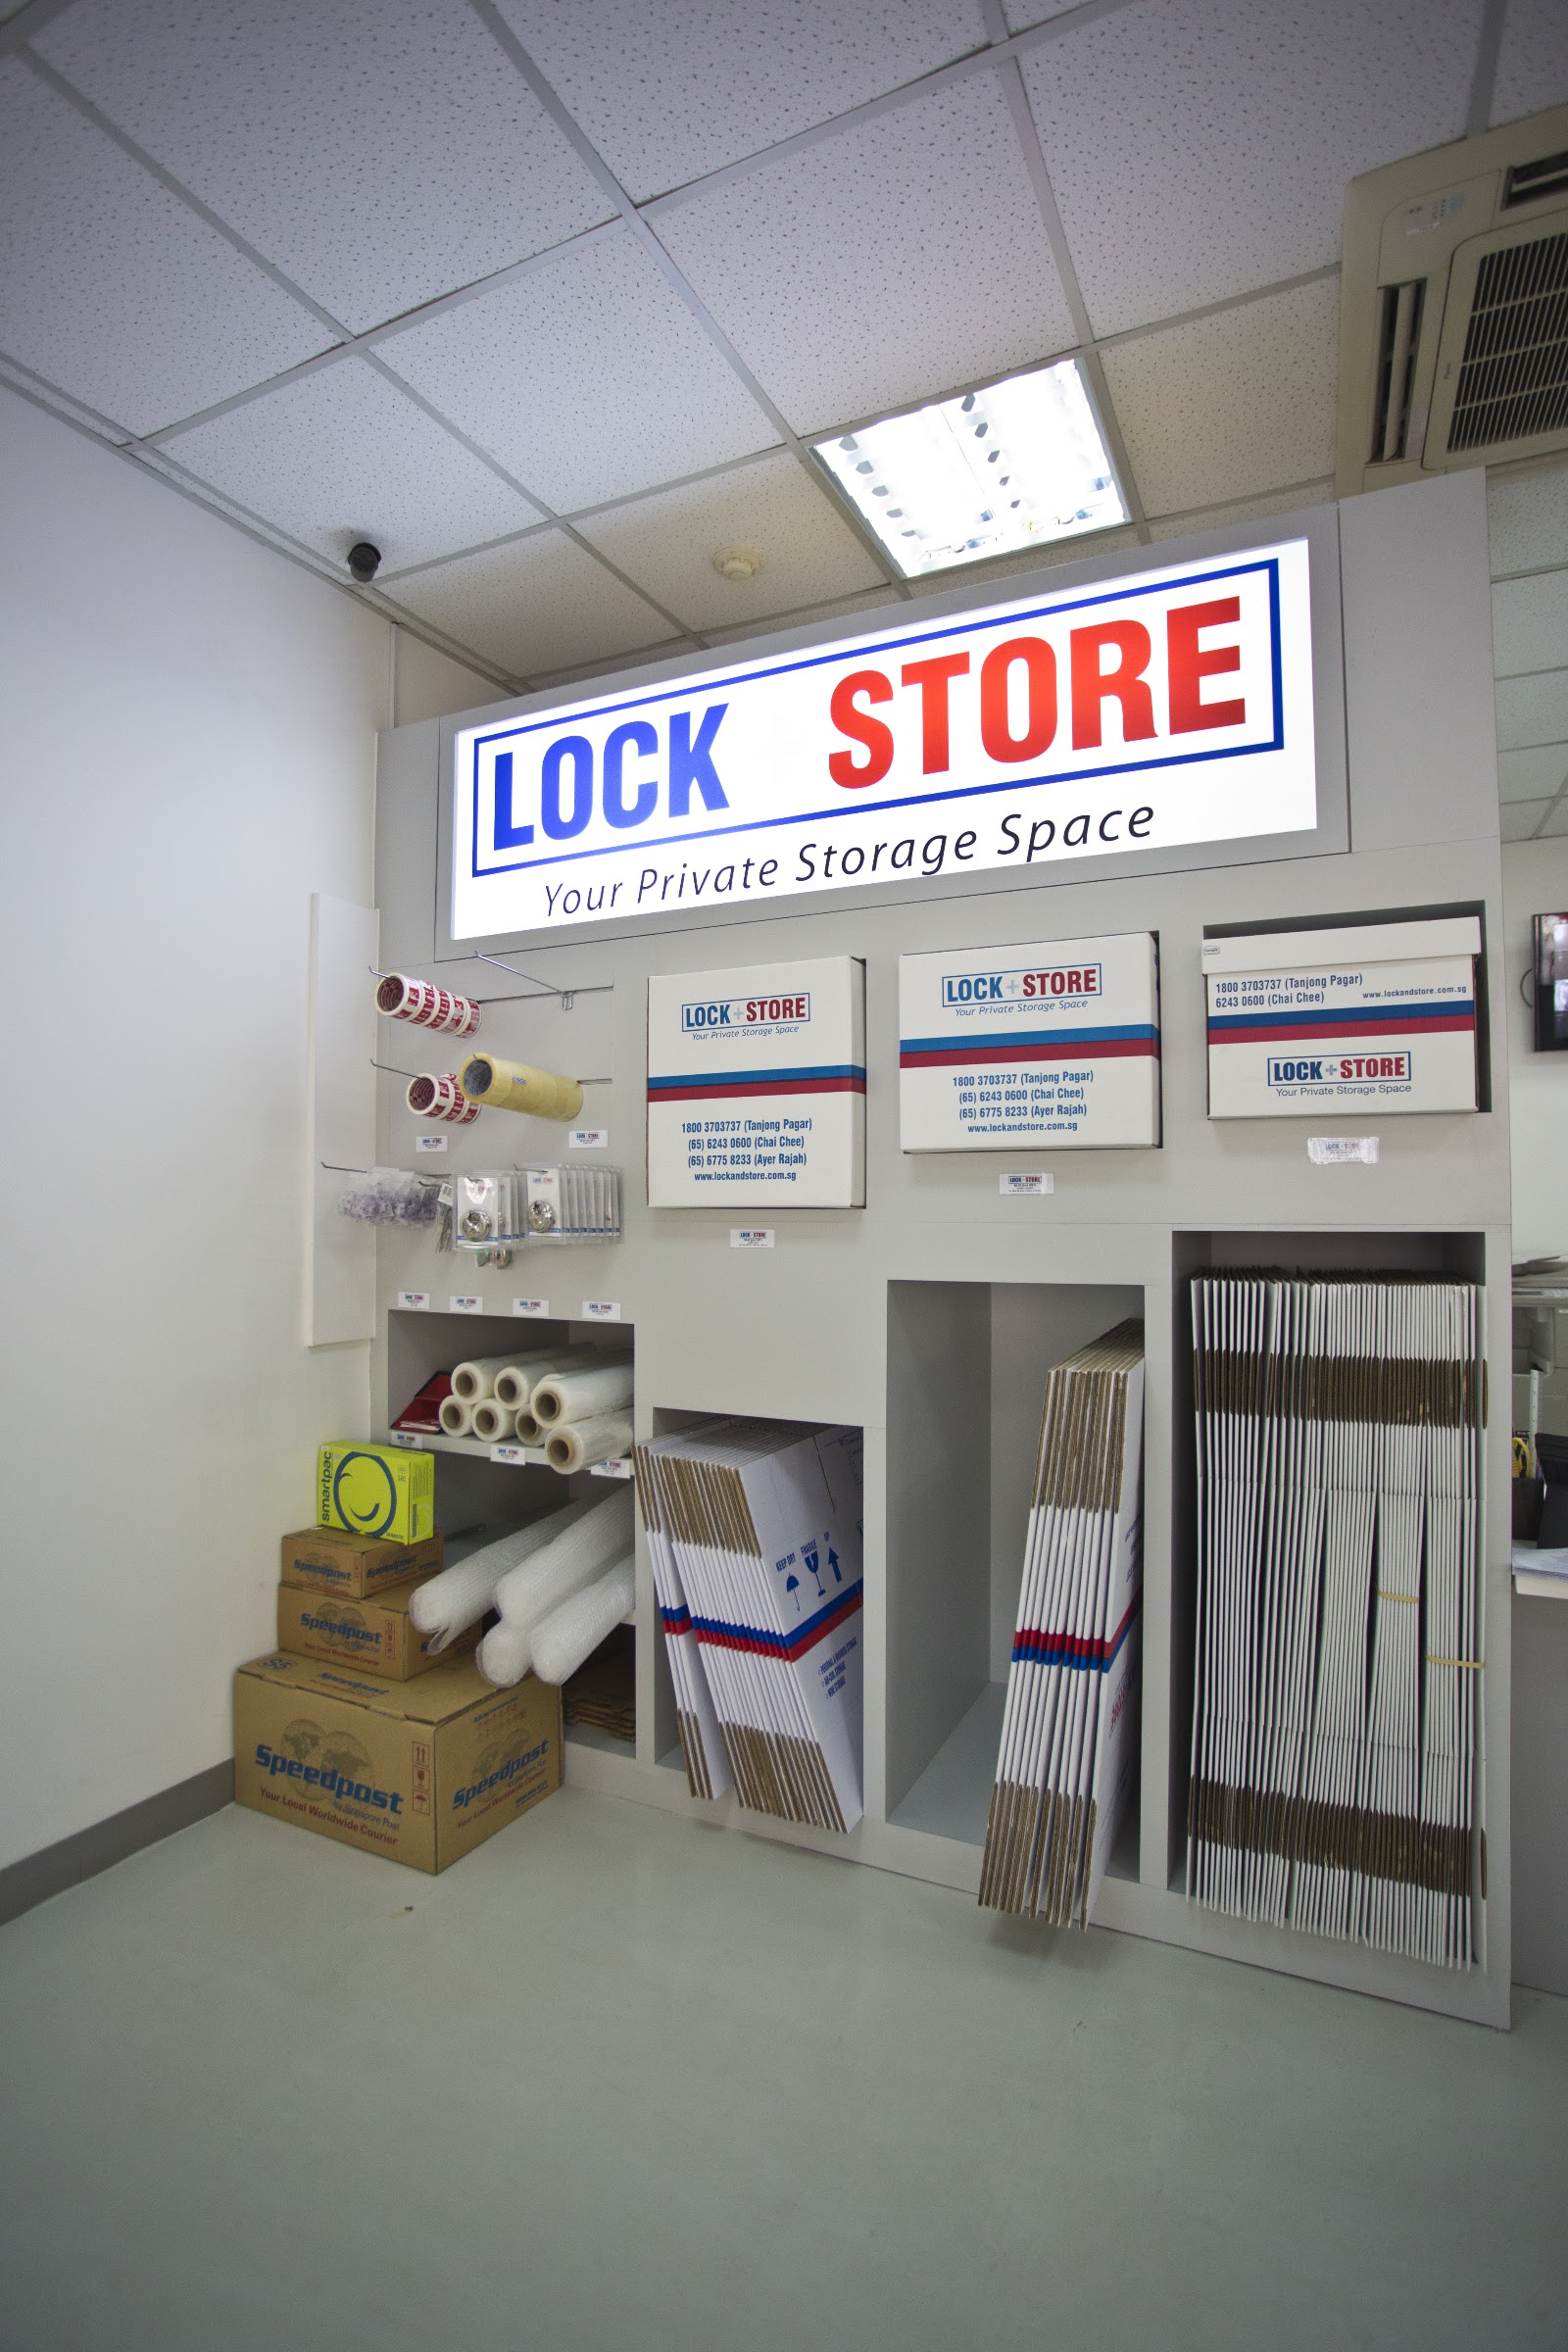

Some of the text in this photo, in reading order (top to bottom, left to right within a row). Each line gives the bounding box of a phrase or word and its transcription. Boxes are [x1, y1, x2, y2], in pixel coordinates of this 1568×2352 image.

[494, 596, 1245, 851] LOCK STORE
[544, 806, 1154, 917] Your Private Storage Space
[947, 976, 1003, 1002] LOCK
[1023, 969, 1097, 997] STORE
[1215, 973, 1362, 994] 1800 3703737 (Tanjong Pagar)
[1215, 992, 1325, 1007] 6243 0600 (Chai Chee)
[1362, 986, 1466, 999] www.lockandstore.com.sg
[686, 1004, 730, 1027] LOCK
[746, 997, 806, 1021] STORE
[956, 1000, 1088, 1016] Your Private Storage Space
[711, 1029, 739, 1039] Private
[742, 1027, 772, 1037] Storage
[775, 1025, 799, 1035] Space
[1274, 1061, 1322, 1082] LOCK
[1341, 1056, 1404, 1078] STORE
[953, 1070, 1094, 1087] 1800 3703737 (Tanjong Pagar)
[959, 1088, 1084, 1103] (65) 6243 0600 (Chai Chee)
[1276, 1084, 1411, 1097] Your Private Storage Space
[959, 1104, 1087, 1120] (65) 6775 8233 (Ayer Rajah)
[682, 1118, 812, 1133] 1800 3703737 (Tanjong Pagar)
[968, 1121, 1077, 1132] www.lockandstore.com.sg
[688, 1135, 805, 1151] (65) 6243 0600 (Chai Chee)
[688, 1152, 807, 1167] (65) 6775 8233 (Ayer Rajah)
[695, 1171, 796, 1181] www.lockandstore.com.sg
[321, 1451, 332, 1522] smartpac
[294, 1559, 352, 1581] Speedpost
[775, 1557, 787, 1573] KEEP
[301, 1612, 382, 1644] Speedpost
[255, 1743, 404, 1815] Speedpost
[453, 1740, 549, 1810] Speedpost
[261, 1787, 397, 1845] Your Local Worldwide Courier
[344, 1804, 381, 1824] Singapore
